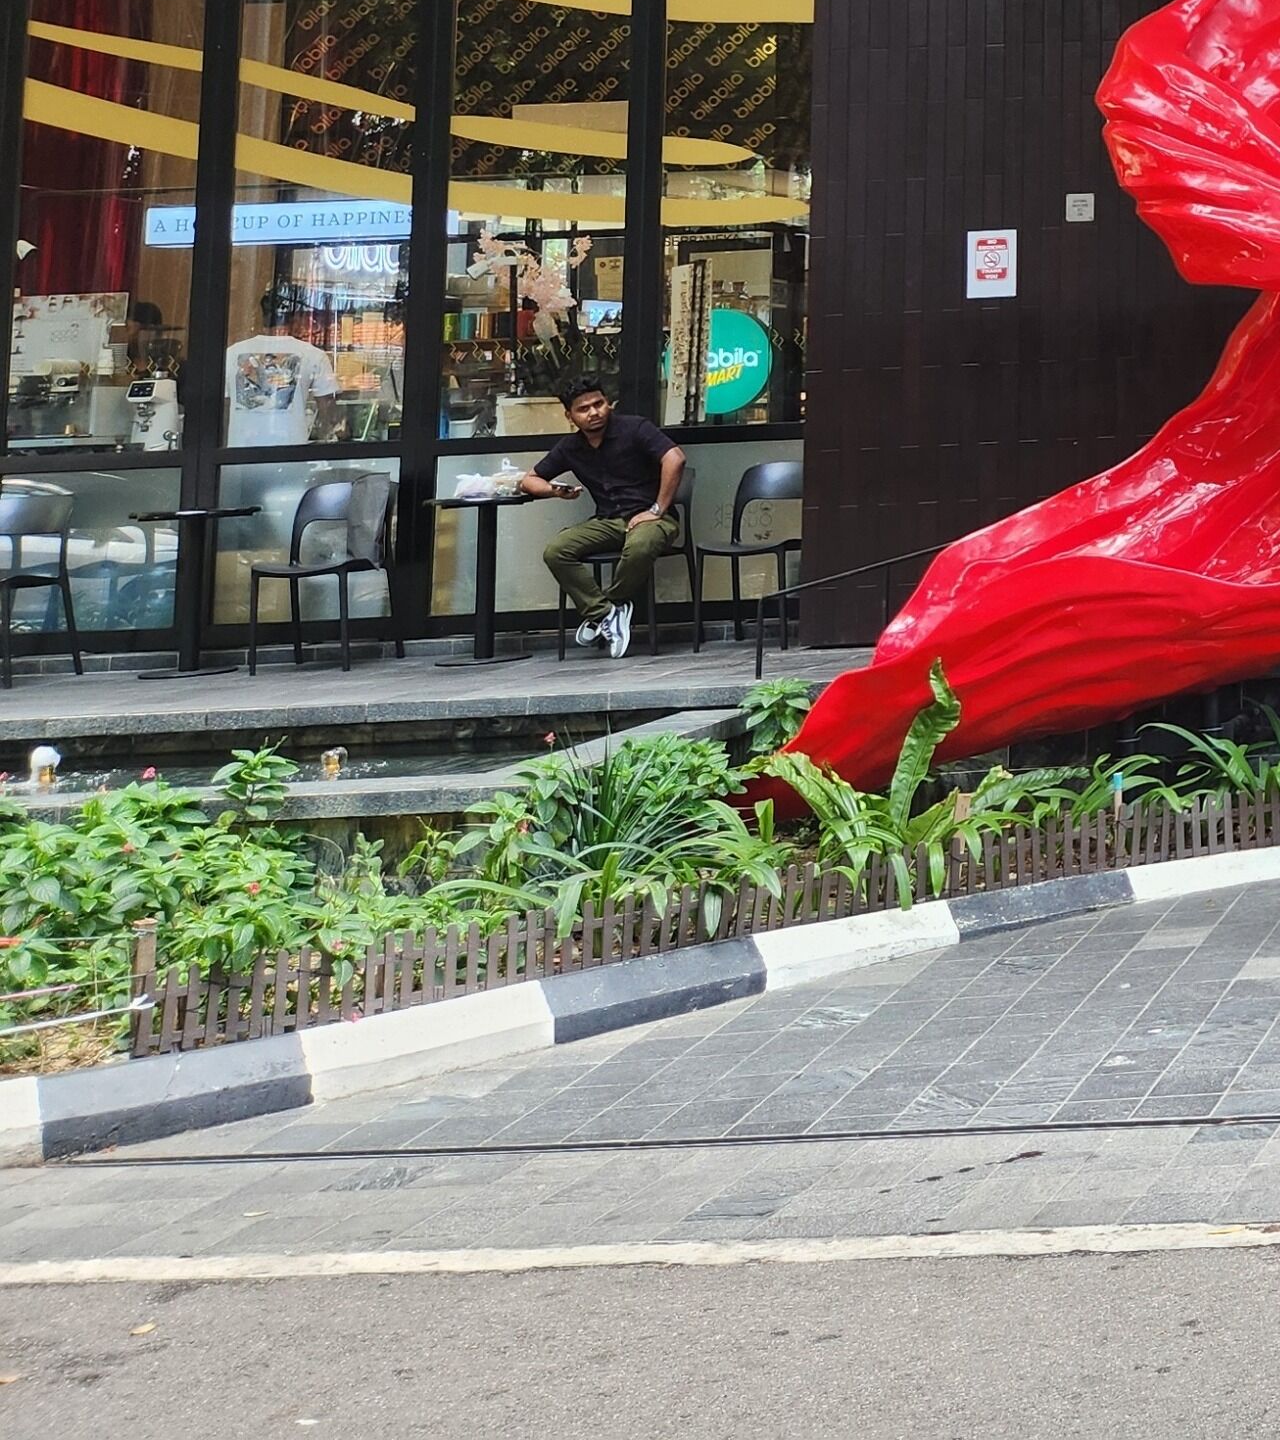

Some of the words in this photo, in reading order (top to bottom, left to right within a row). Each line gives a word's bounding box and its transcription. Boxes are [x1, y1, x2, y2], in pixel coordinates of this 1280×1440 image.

[154, 218, 168, 233] A
[277, 213, 304, 229] OF
[311, 209, 413, 228] HAPPINES
[705, 347, 755, 368] abila
